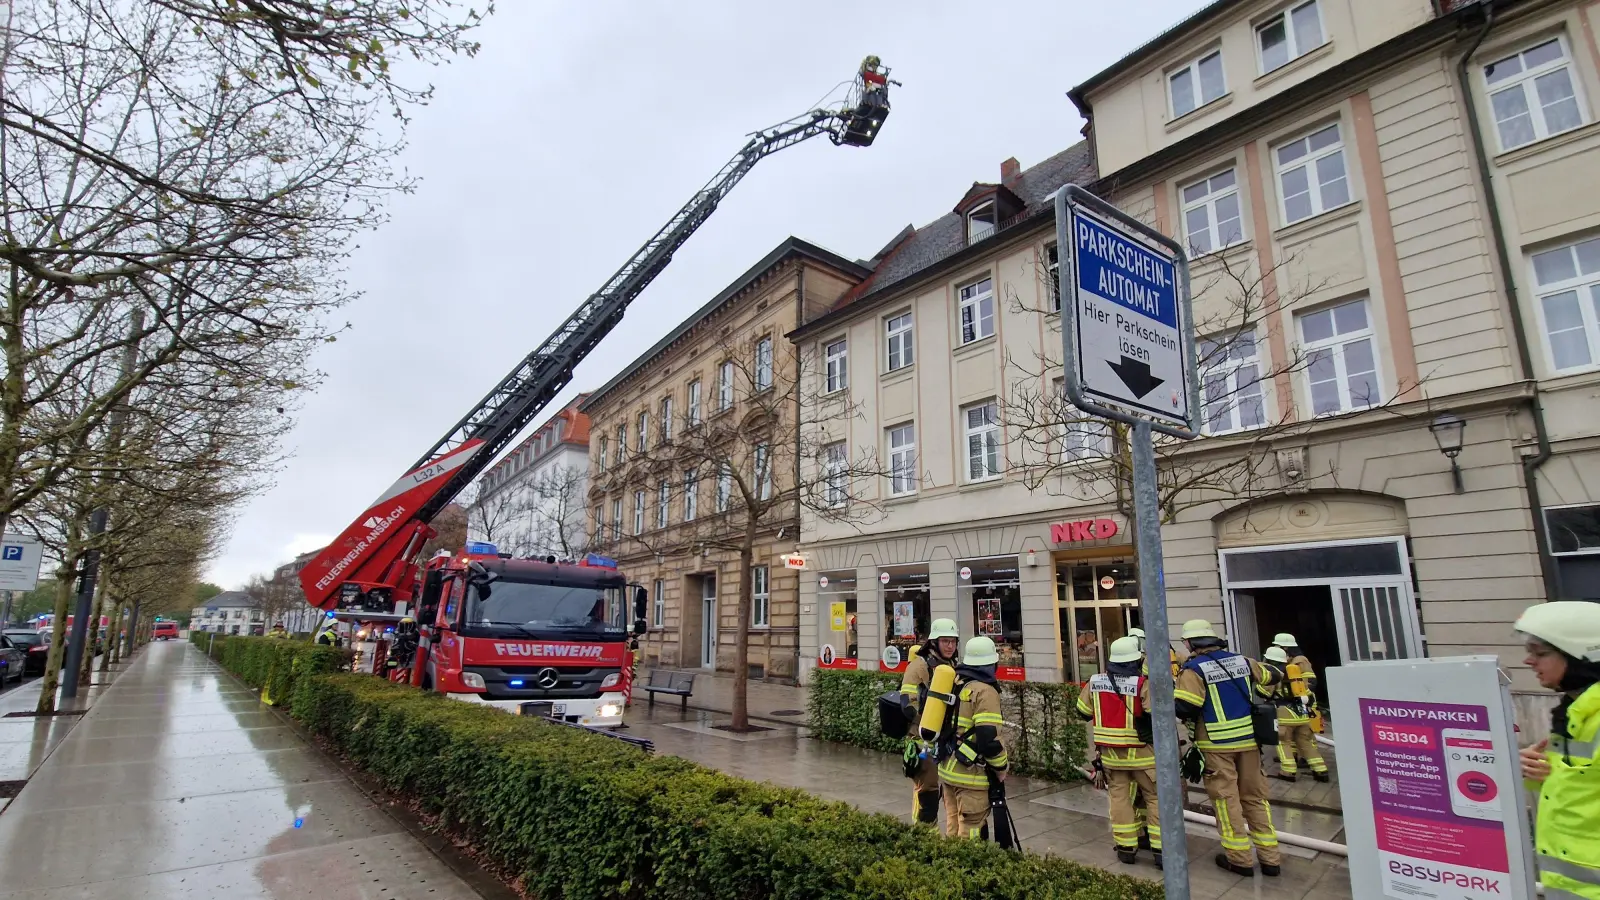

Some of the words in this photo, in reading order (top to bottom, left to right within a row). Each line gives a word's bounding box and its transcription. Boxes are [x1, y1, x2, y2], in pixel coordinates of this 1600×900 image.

[1079, 222, 1172, 288] PARKSCHEIN-
[1098, 267, 1160, 317] AUTOMAT
[1084, 299, 1110, 325] Hier
[1116, 313, 1176, 352] Parkschein
[1119, 335, 1150, 361] lösen
[413, 468, 435, 483] L32
[437, 464, 445, 473] A
[1050, 518, 1118, 544] NKD
[6, 547, 19, 559] P
[315, 541, 369, 591] FEUERWEHR
[366, 505, 406, 543] ANSBACH
[788, 558, 804, 566] NKD
[494, 643, 603, 657] FEUERWEHR
[1208, 670, 1236, 682] Ansbah
[1091, 683, 1121, 692] Ansbah
[1124, 686, 1135, 694] 1/4
[1368, 705, 1478, 724] HANDYPARKEN
[1378, 730, 1429, 745] 931304
[1374, 750, 1417, 761] Kostenlos
[1418, 754, 1433, 763] die
[1466, 754, 1495, 765] 14:27
[1375, 758, 1440, 773] EasyPark-App
[1376, 766, 1441, 780] herunterladen
